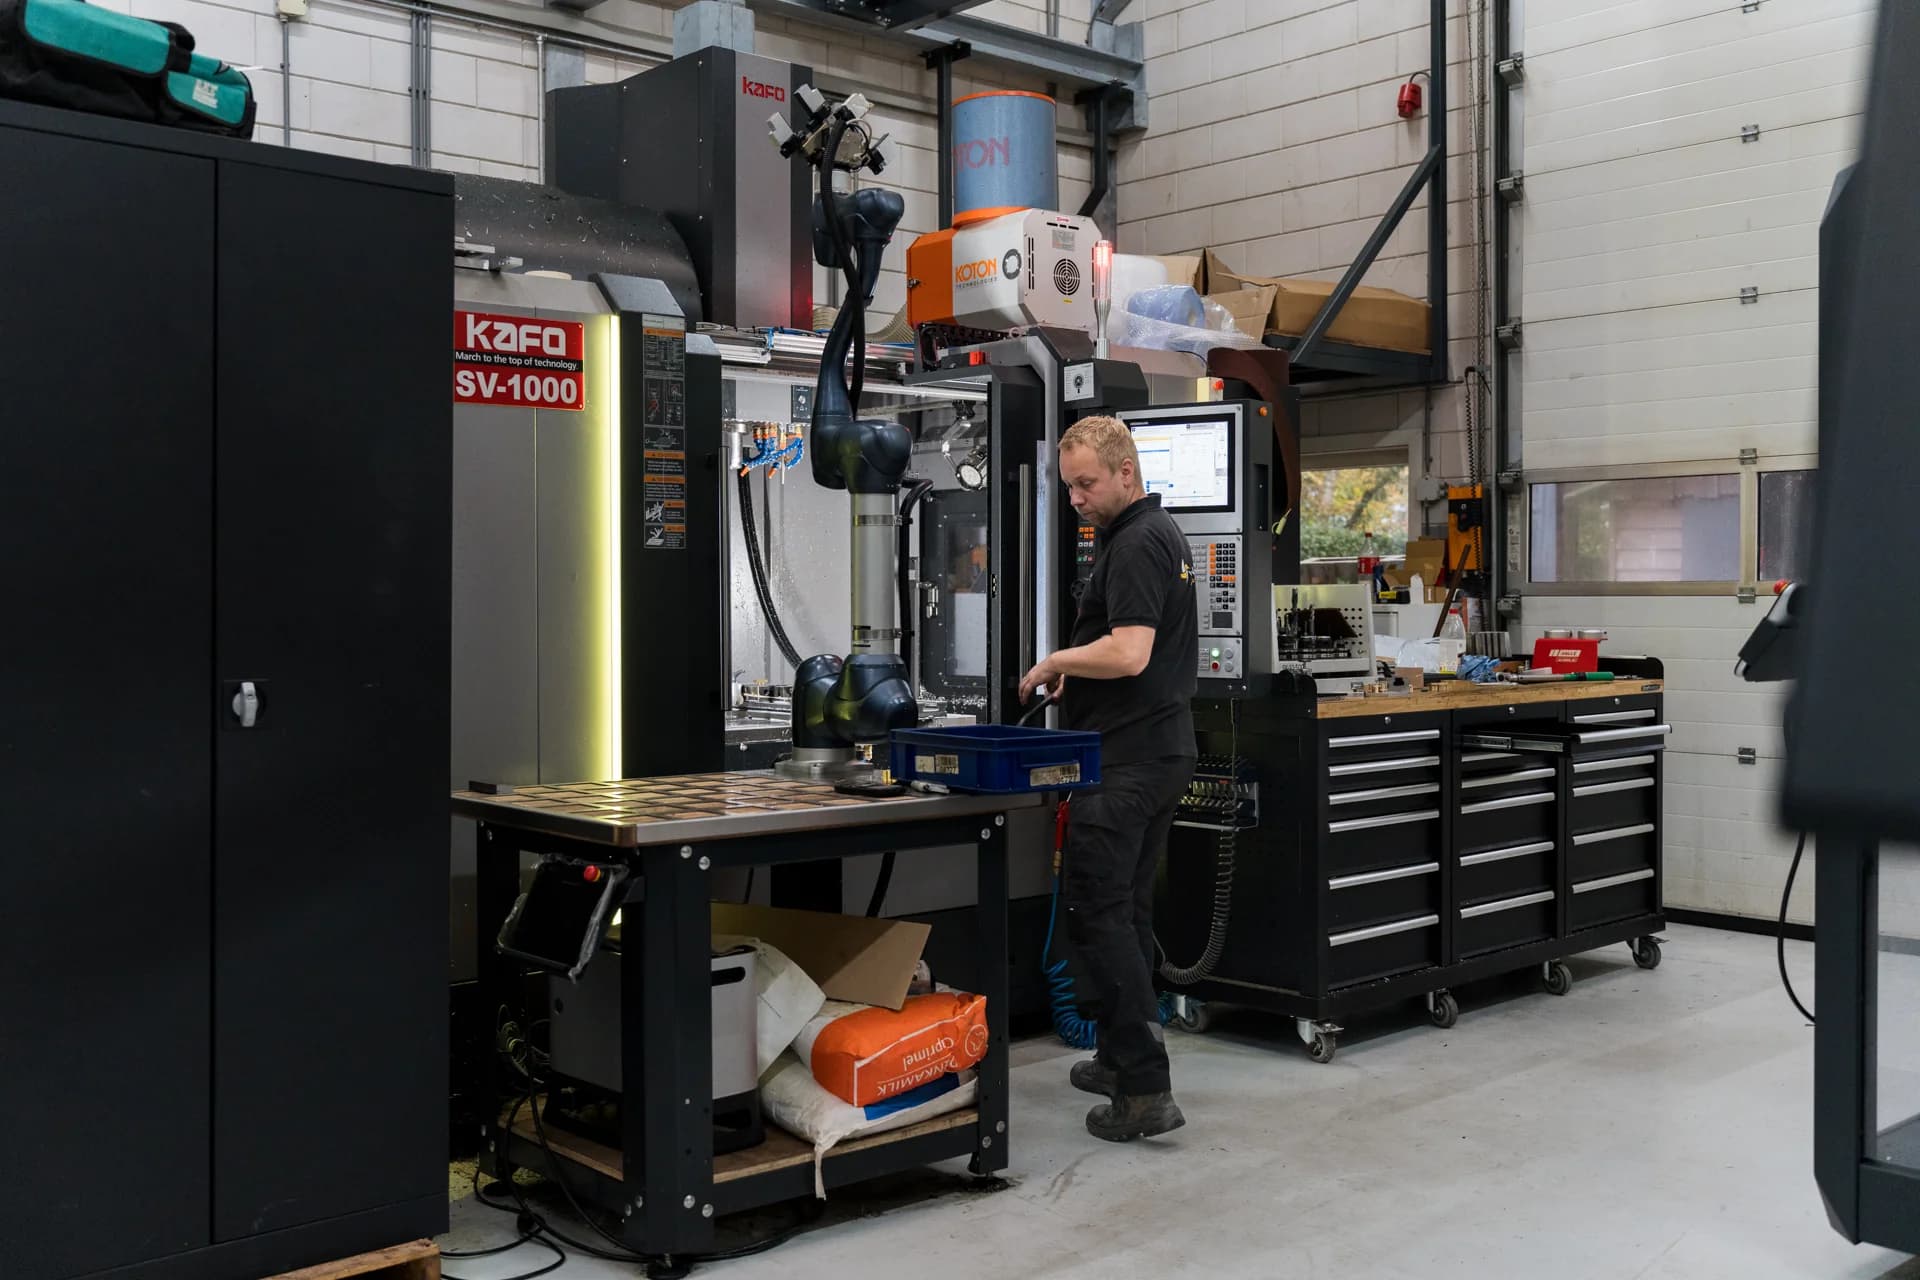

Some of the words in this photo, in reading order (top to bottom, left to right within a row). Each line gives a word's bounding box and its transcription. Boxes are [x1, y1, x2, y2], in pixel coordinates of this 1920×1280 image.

[955, 257, 997, 283] KOTON
[455, 351, 481, 362] March
[483, 354, 492, 362] to
[494, 354, 507, 364] the
[508, 356, 522, 366] top
[524, 357, 533, 366] of
[456, 370, 577, 404] SV-1000
